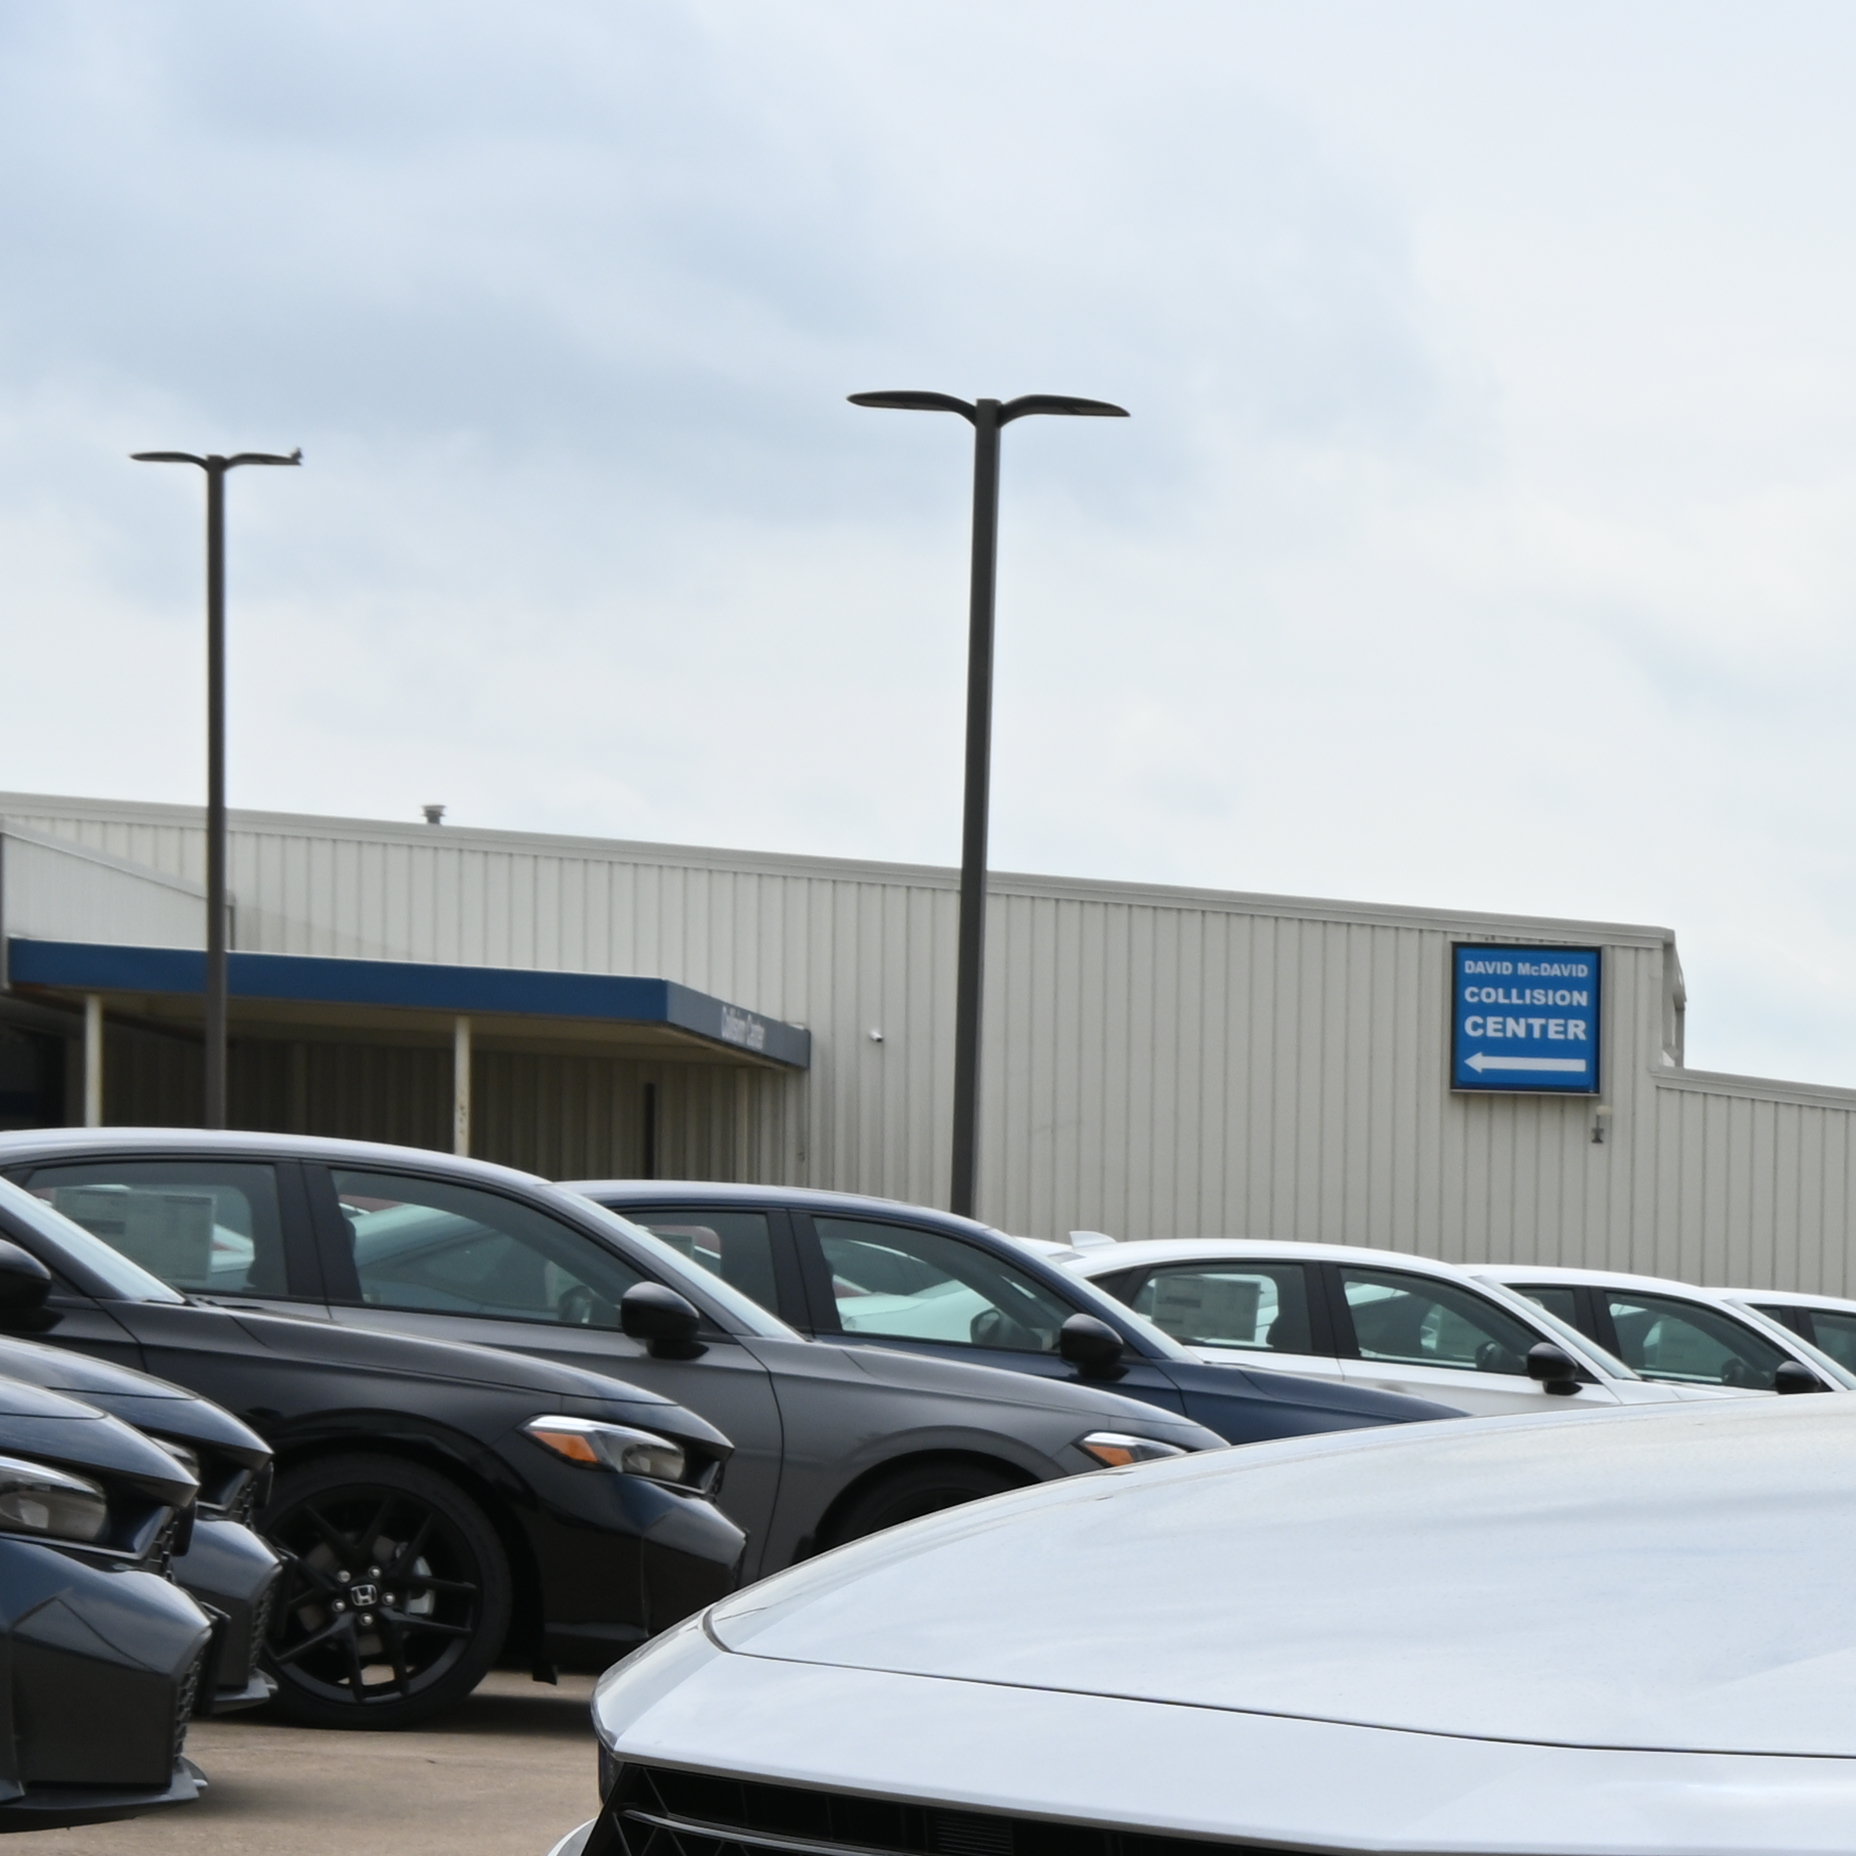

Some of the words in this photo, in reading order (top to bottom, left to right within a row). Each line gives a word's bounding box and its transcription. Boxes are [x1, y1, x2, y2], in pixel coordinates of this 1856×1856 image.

[1464, 960, 1513, 975] DAVID
[1517, 962, 1588, 977] McDAVID
[1464, 986, 1588, 1006] COLLISION
[1464, 1015, 1587, 1040] CENTER
